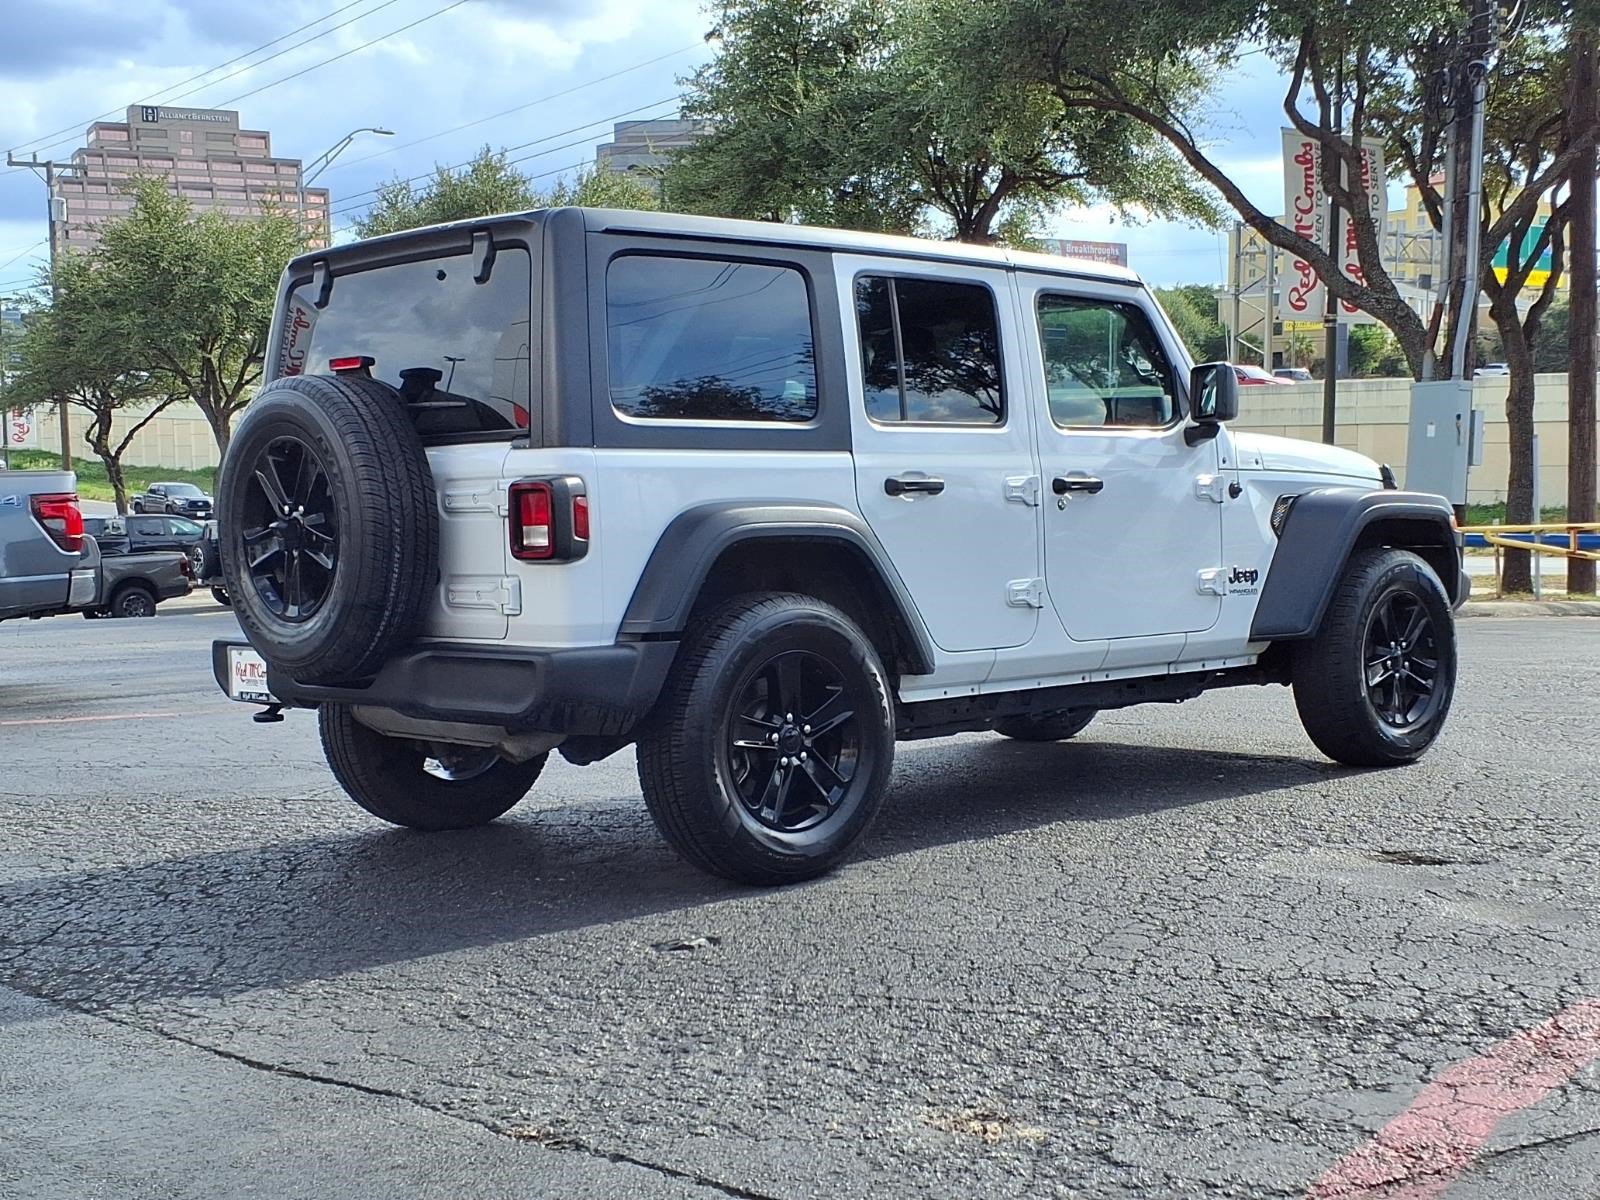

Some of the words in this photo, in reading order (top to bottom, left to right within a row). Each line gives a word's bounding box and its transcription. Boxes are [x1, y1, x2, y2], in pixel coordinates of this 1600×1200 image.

[1369, 149, 1379, 190] SERVE
[1316, 190, 1323, 208] TO
[1371, 194, 1380, 212] TO
[1289, 260, 1318, 312] Red
[12, 422, 30, 443] Red
[1228, 567, 1258, 586] Jeep
[236, 662, 247, 682] Red
